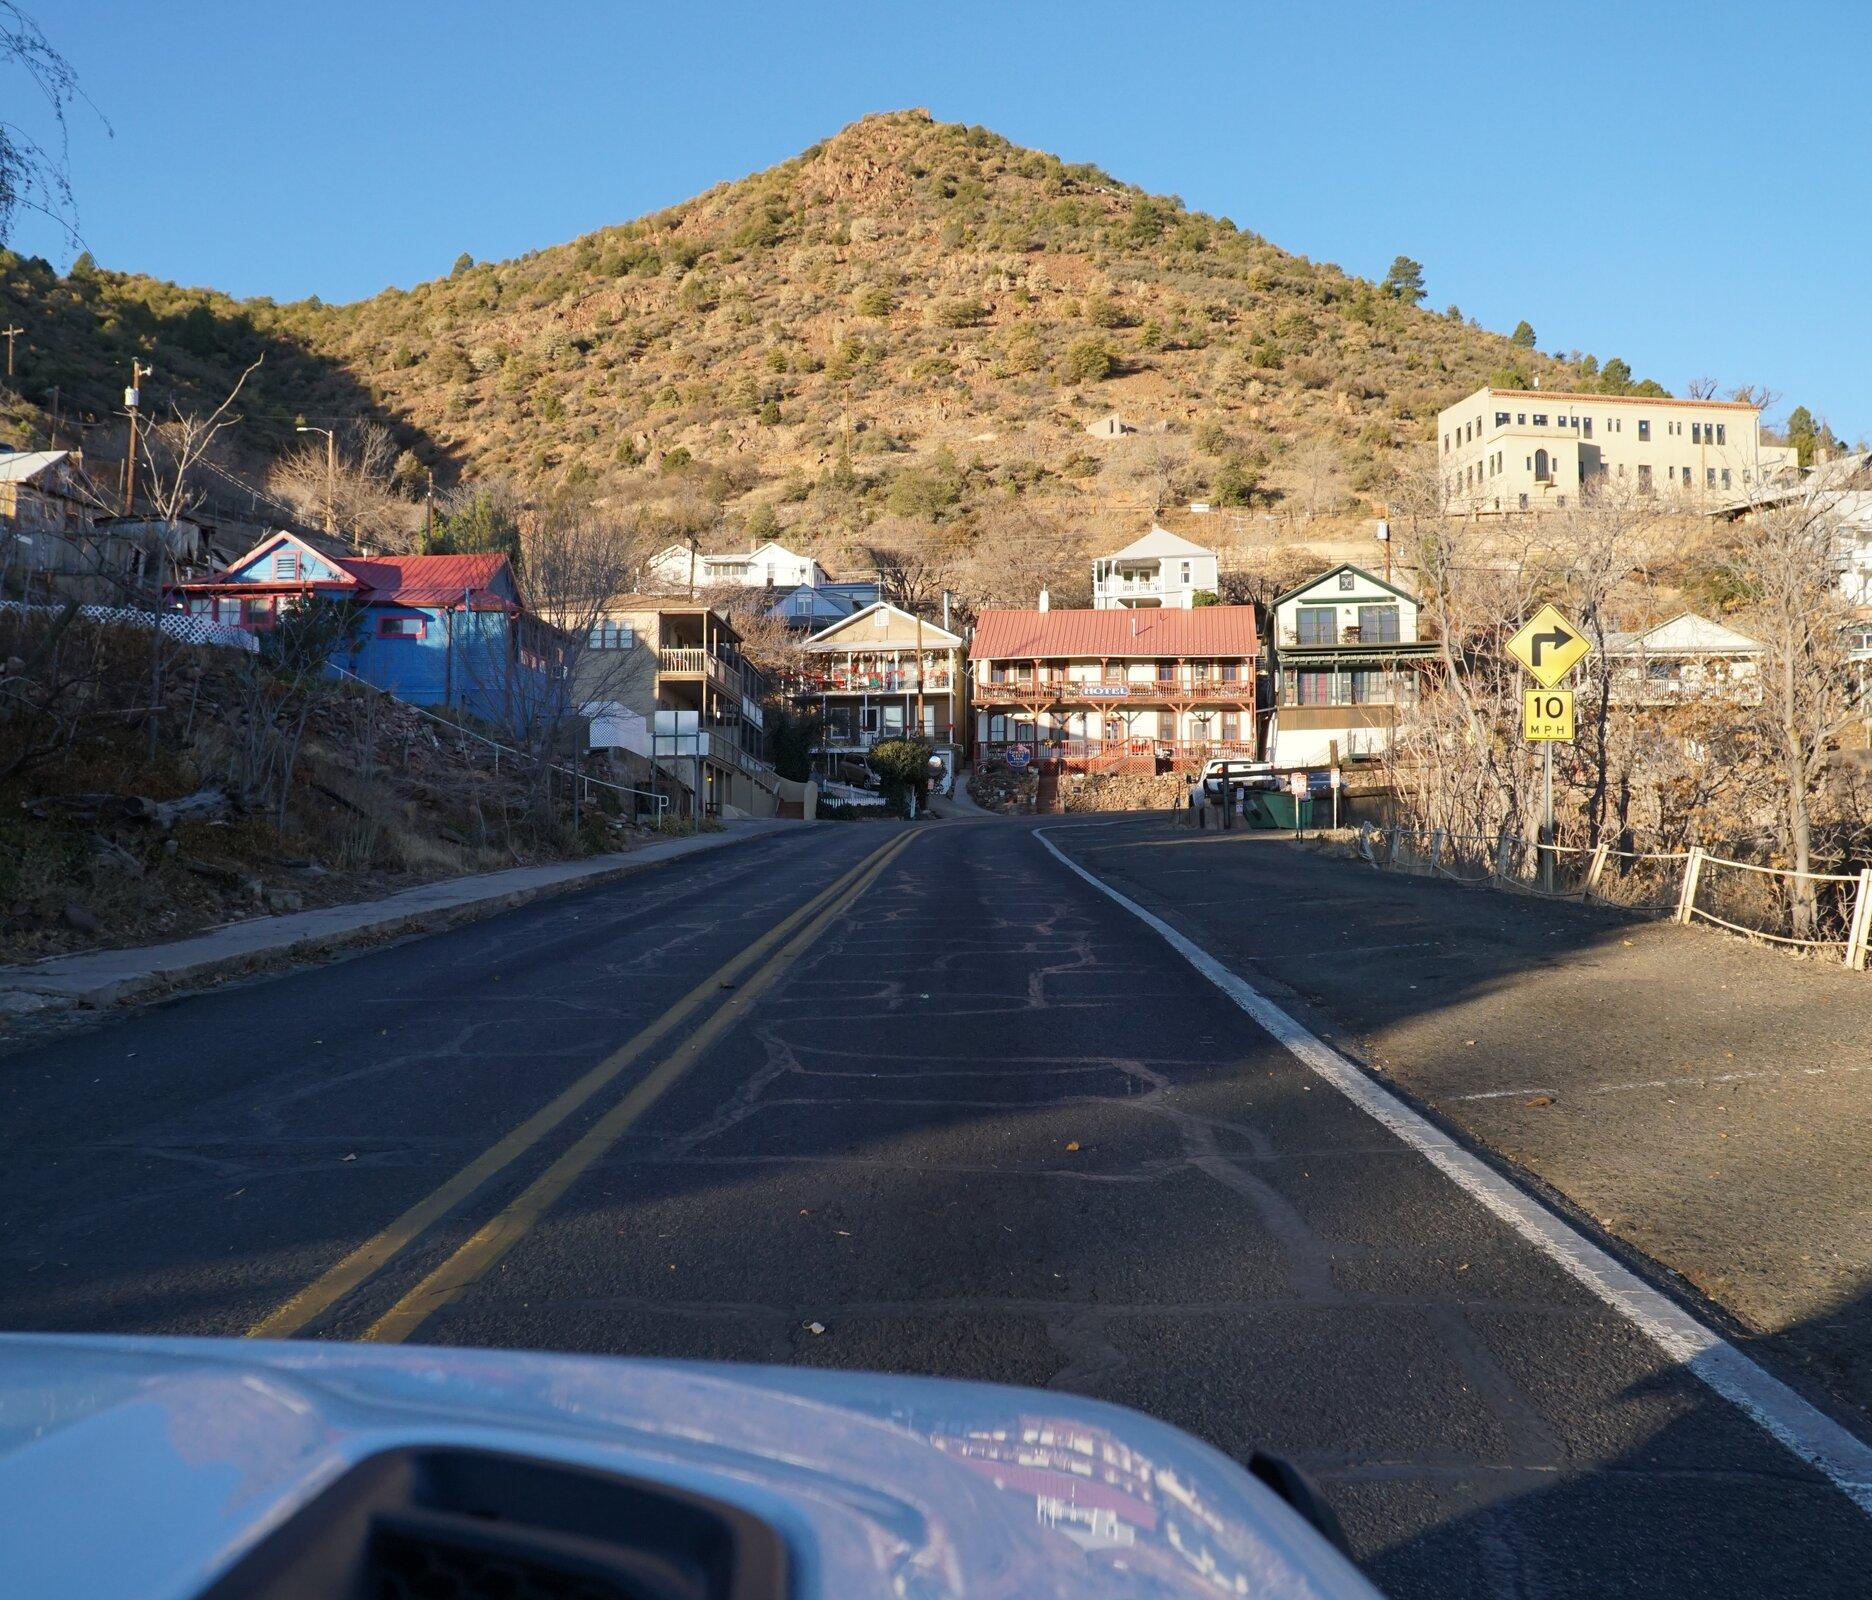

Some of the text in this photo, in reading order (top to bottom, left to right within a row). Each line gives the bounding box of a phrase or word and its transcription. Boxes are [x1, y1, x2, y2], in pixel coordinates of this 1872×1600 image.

[1084, 687, 1128, 695] HOTEL
[1534, 697, 1563, 718] 10
[1531, 725, 1564, 734] MPH
